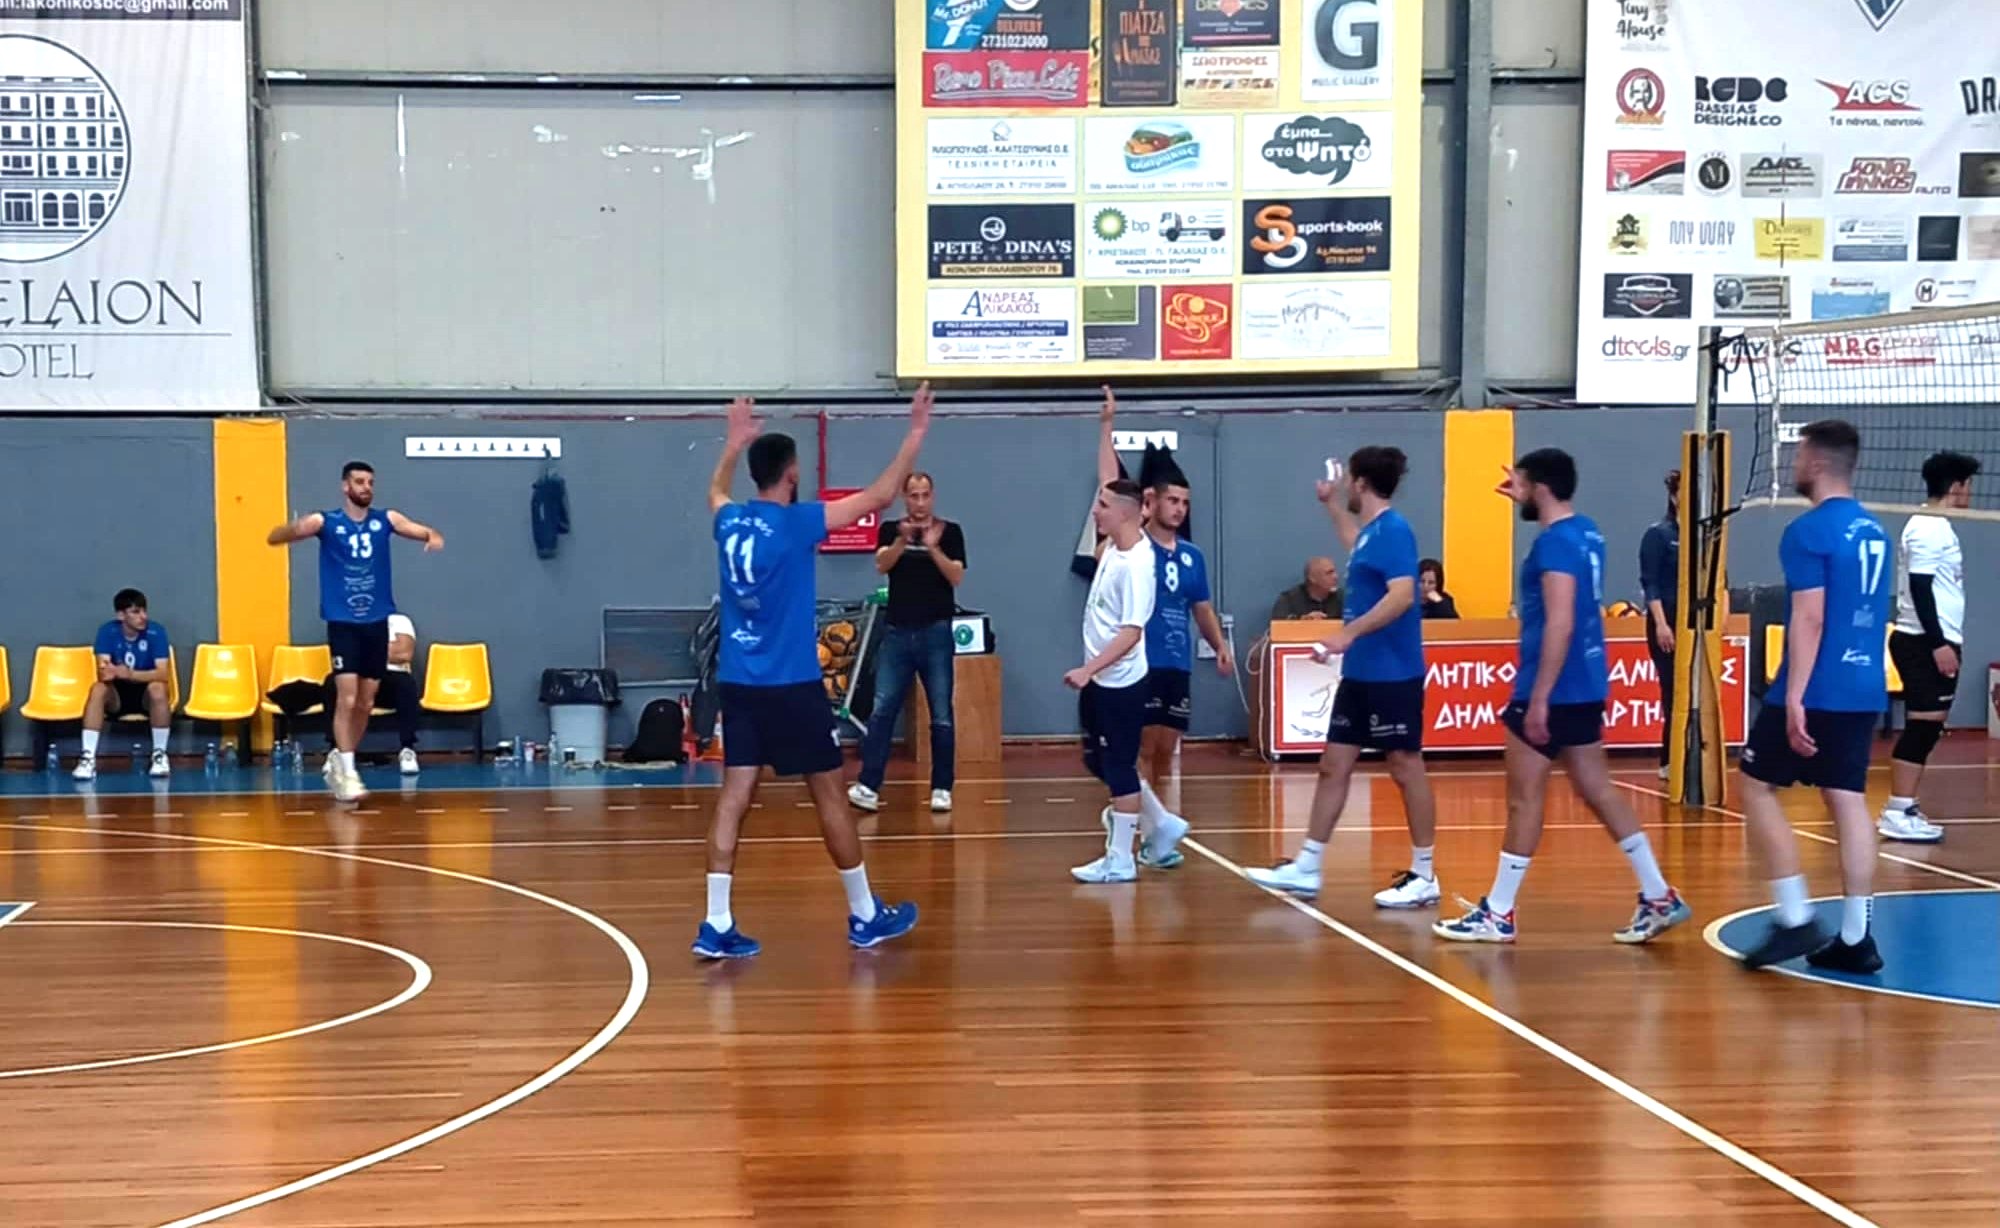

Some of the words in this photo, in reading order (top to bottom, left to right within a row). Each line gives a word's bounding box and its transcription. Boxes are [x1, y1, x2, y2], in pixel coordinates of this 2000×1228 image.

[997, 19, 1043, 33] DELIVERY
[1119, 11, 1166, 35] ΠΙΑΤΣΑ
[1314, 0, 1379, 71] G
[1615, 19, 1666, 40] House
[980, 34, 1049, 48] 2731023000
[1844, 80, 1912, 105] ACS
[1960, 76, 2000, 116] DR
[1694, 103, 1758, 115] RASSIAS
[1694, 114, 1783, 127] DESIGN&CO
[1264, 146, 1295, 158] στο
[1296, 138, 1372, 163] Ψητό
[1131, 219, 1151, 233] bp
[1297, 219, 1384, 235] sports-book
[1669, 220, 1695, 246] MY
[1698, 220, 1737, 246] WAY
[932, 241, 984, 255] PETE
[1005, 239, 1073, 254] DINA'S
[1602, 335, 1691, 361] dtools.gr
[1824, 337, 1882, 357] NRG
[349, 532, 373, 558] 13
[725, 533, 755, 584] 11
[1859, 540, 1886, 596] 17
[1165, 561, 1179, 593] 8
[1423, 661, 1518, 690] ΛΗΤΙΚΟ
